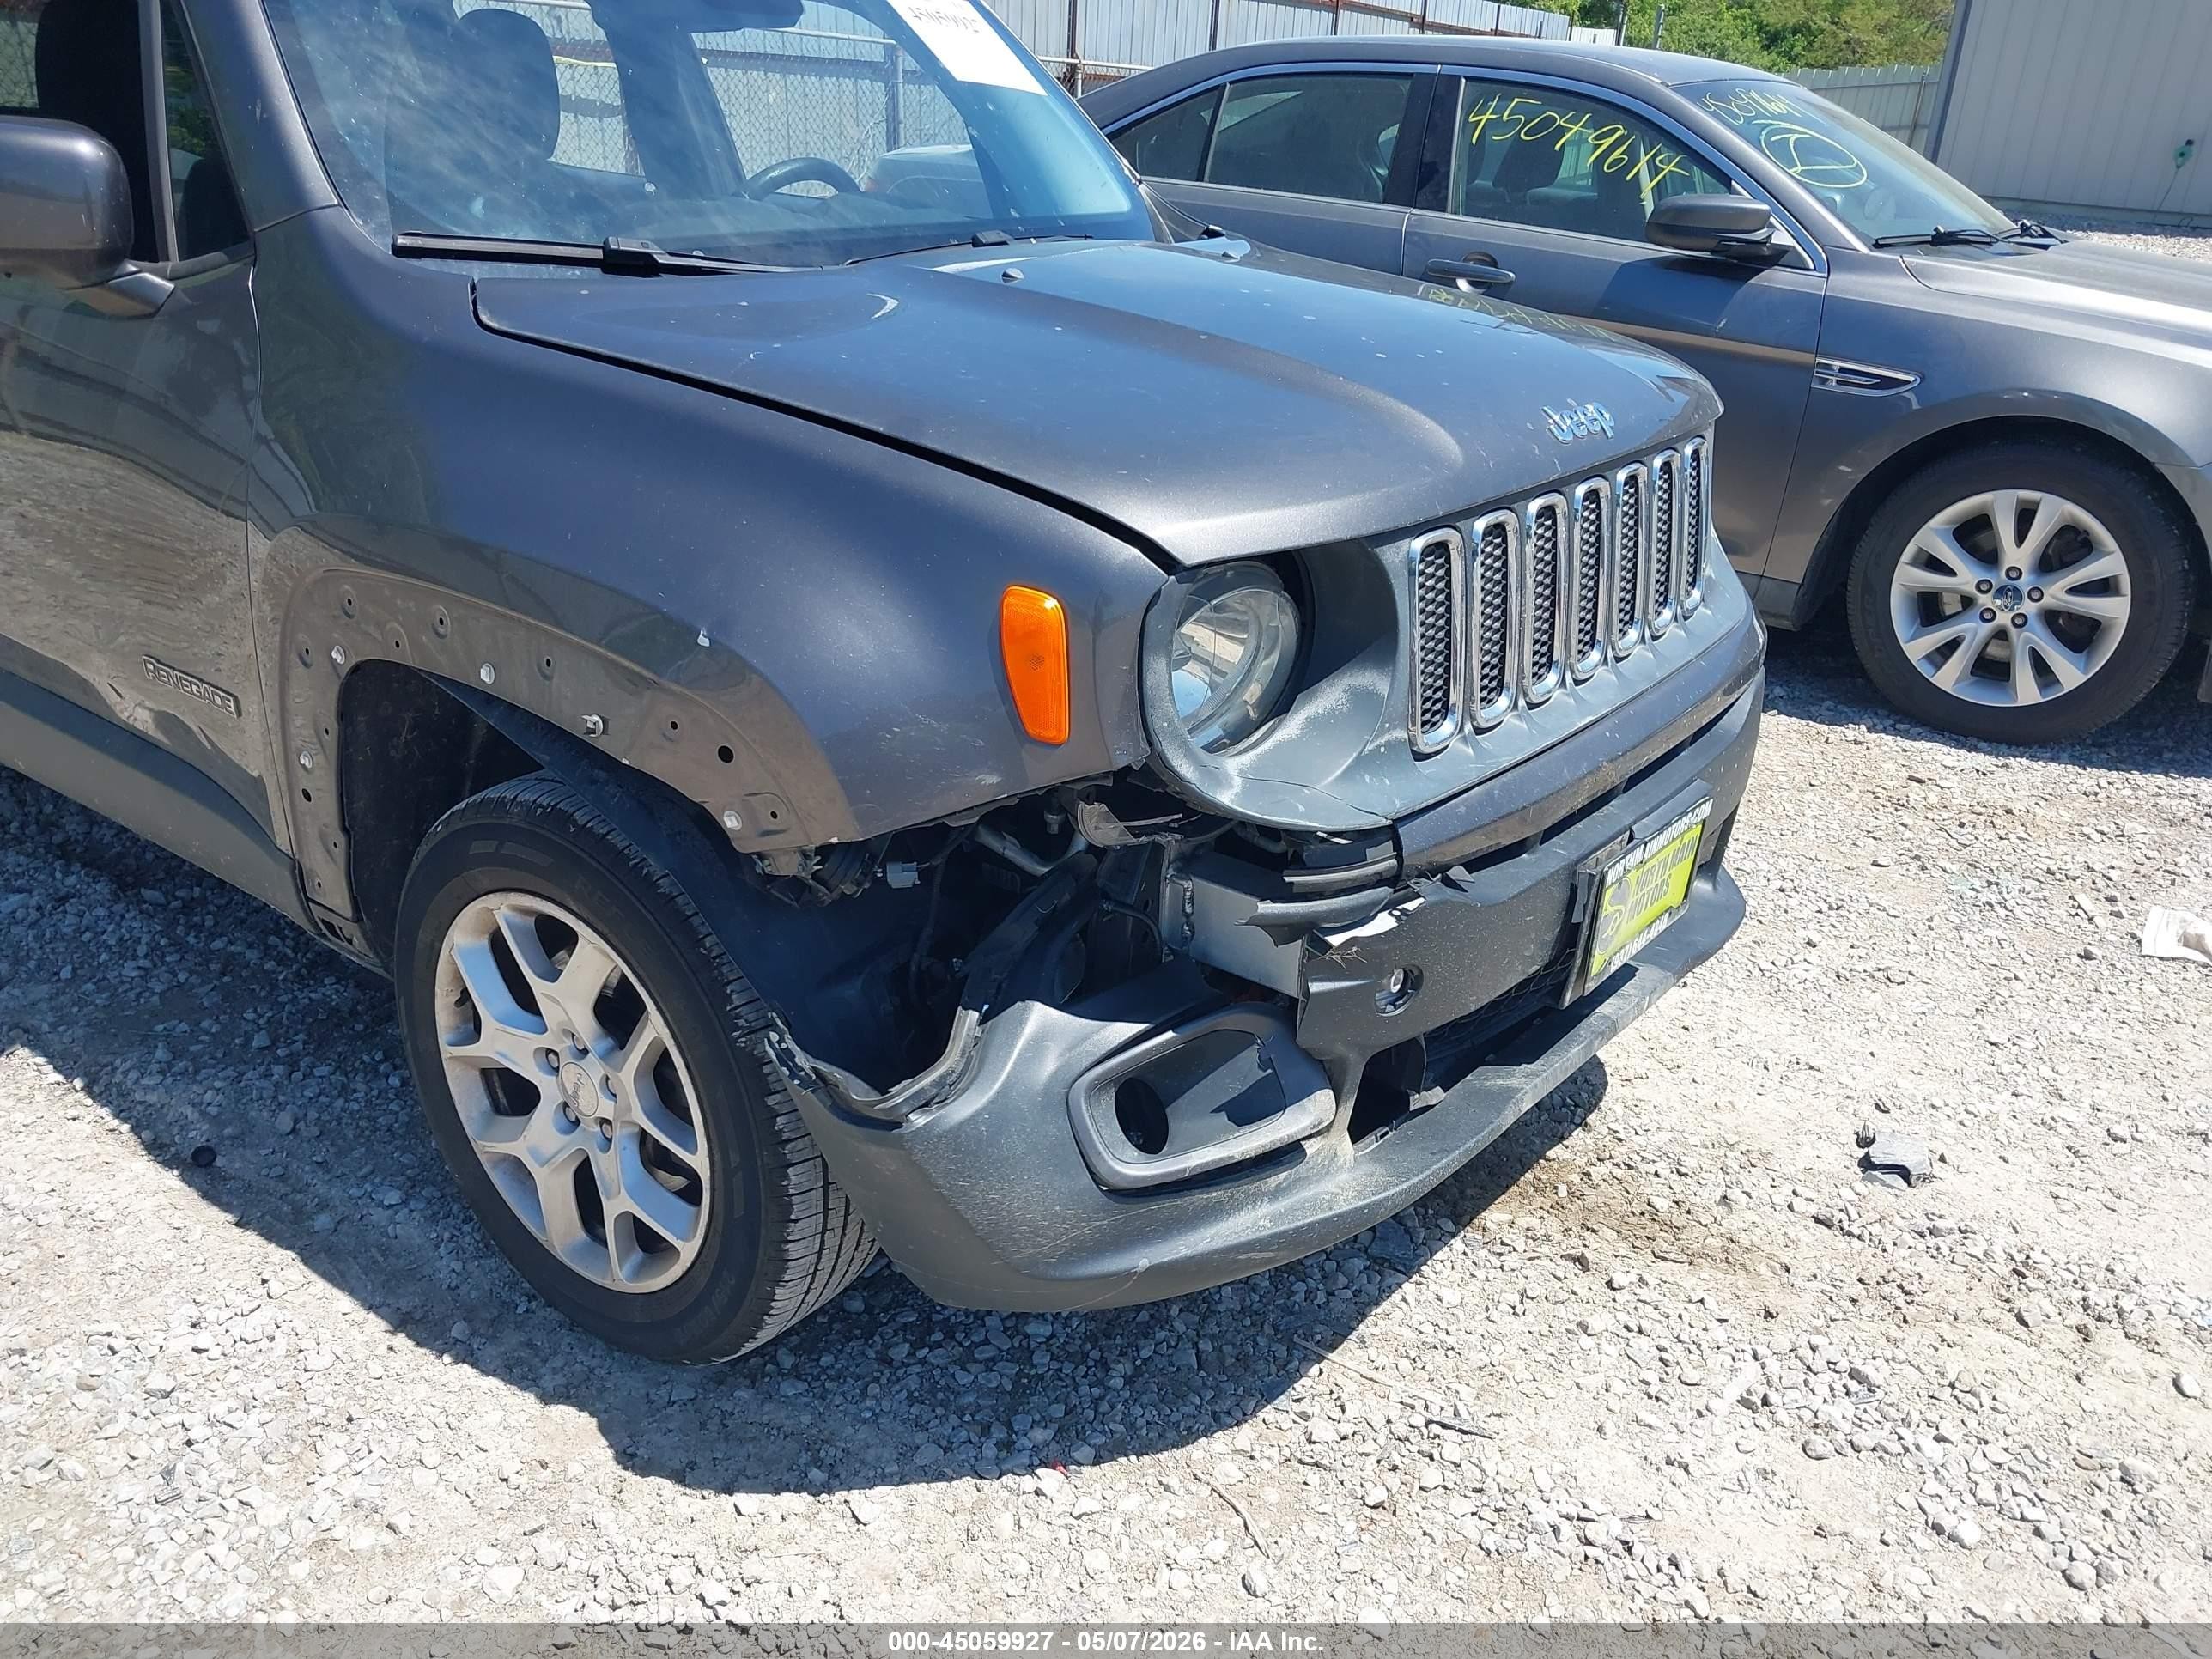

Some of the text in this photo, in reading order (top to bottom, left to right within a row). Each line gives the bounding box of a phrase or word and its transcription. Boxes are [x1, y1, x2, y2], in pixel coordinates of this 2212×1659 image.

[1468, 93, 1691, 200] 45049614
[1540, 400, 1615, 445] Jeep
[142, 654, 242, 720] RENEGADE
[1632, 833, 1699, 898] NORTH MAIN
[1626, 871, 1672, 926] MOTORS
